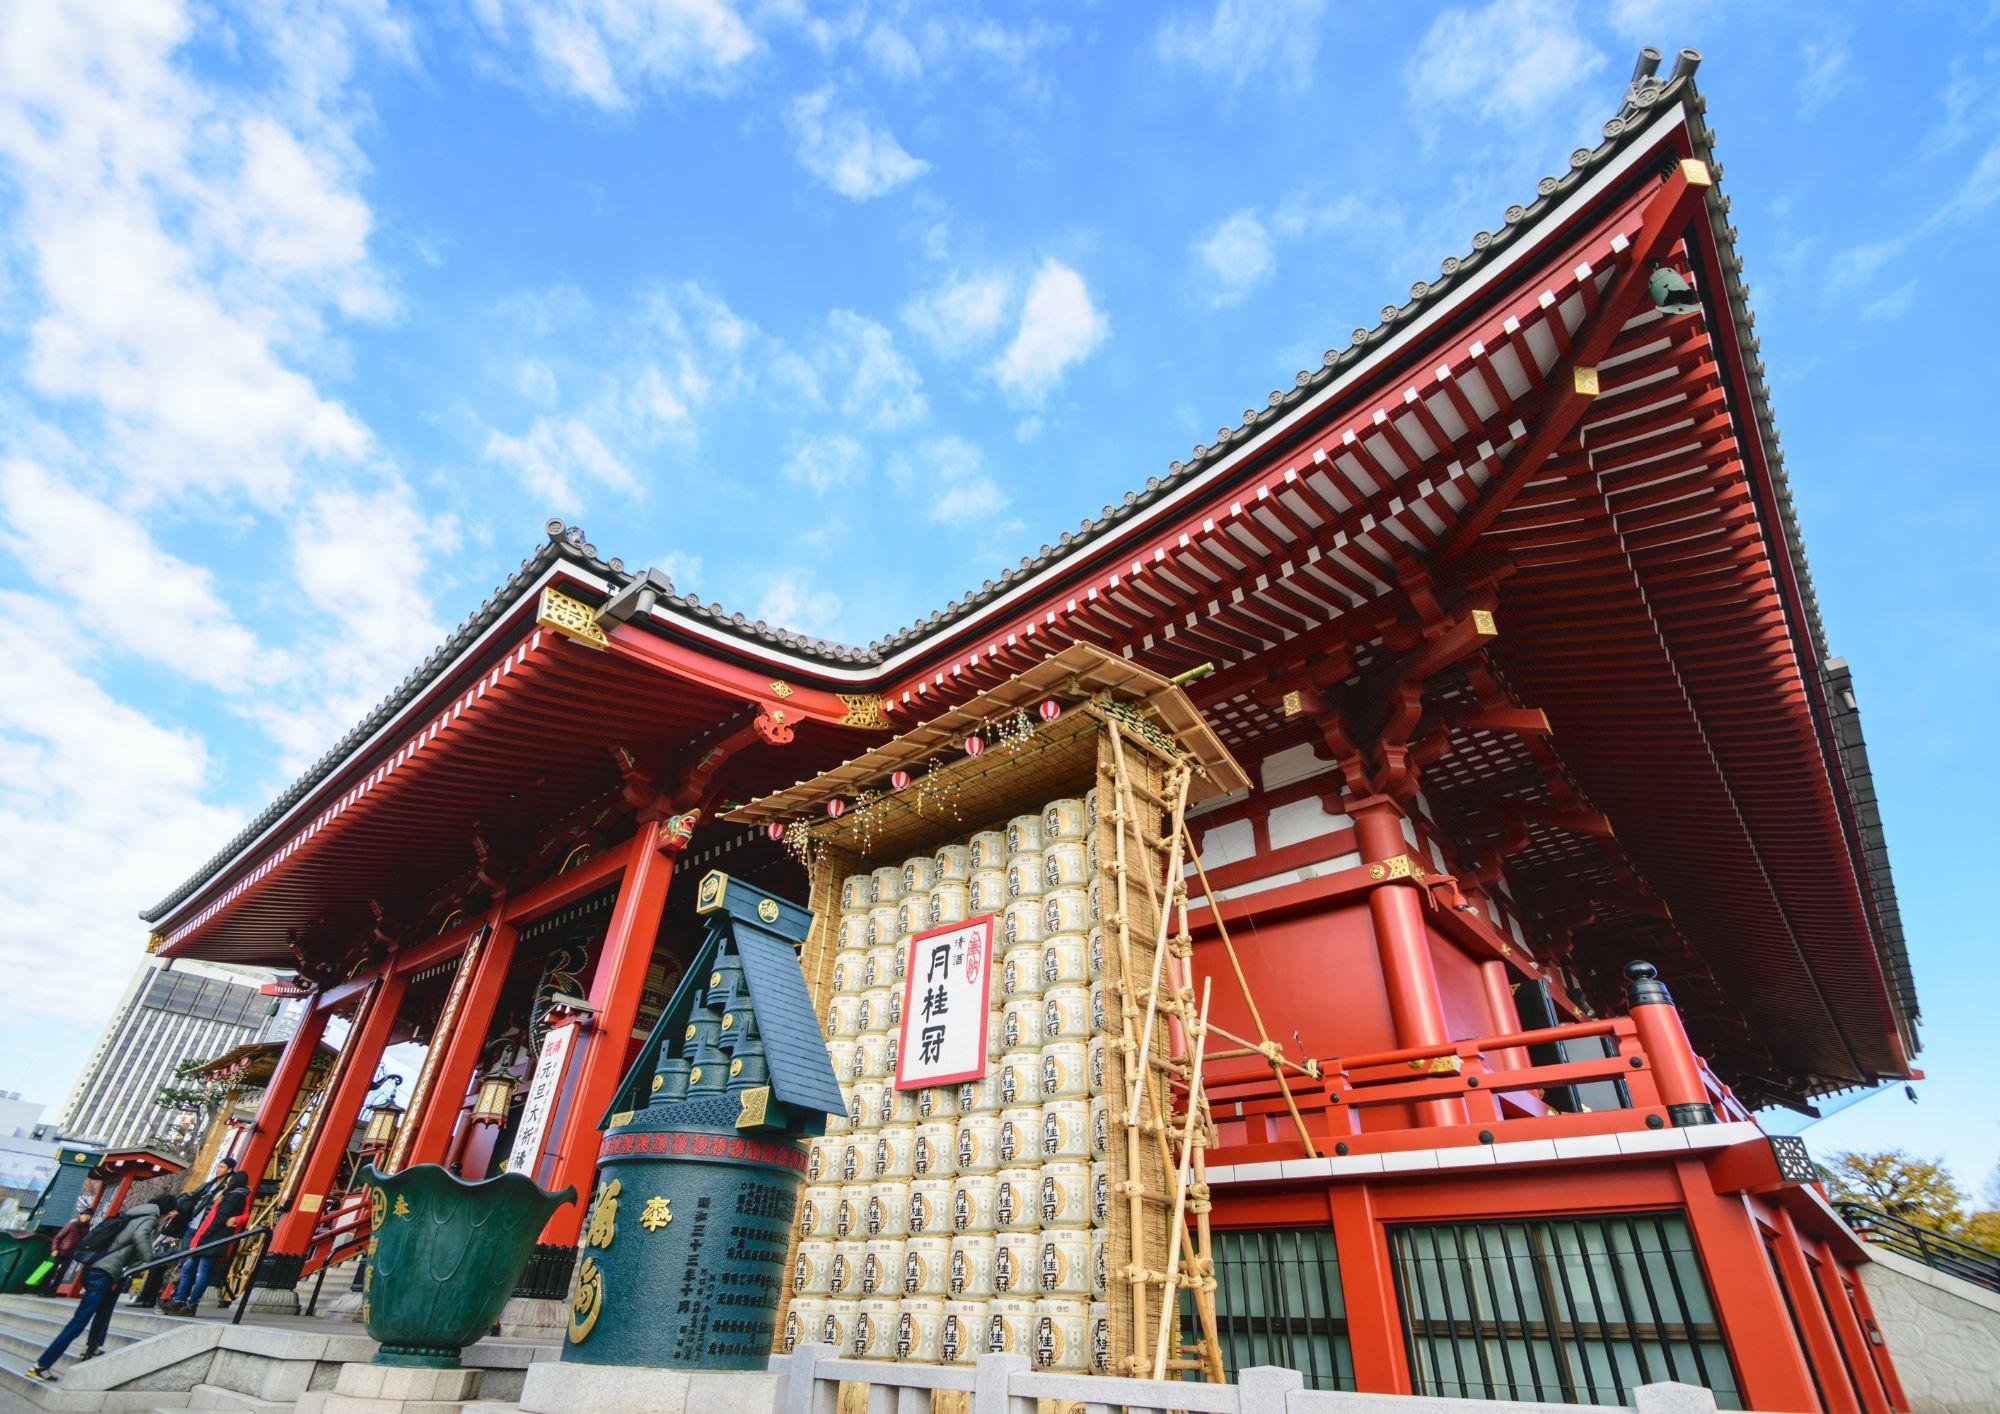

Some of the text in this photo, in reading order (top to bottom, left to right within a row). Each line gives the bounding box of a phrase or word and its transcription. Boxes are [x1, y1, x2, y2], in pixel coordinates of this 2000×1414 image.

[953, 936, 966, 966] 清酒
[919, 943, 951, 1066] 月桂冠
[851, 1094, 861, 1128] 月桂冠
[919, 1088, 931, 1117] 桂冠
[960, 1082, 971, 1111] 桂冠
[959, 1129, 971, 1167] 月桂冠
[1001, 1122, 1014, 1162] 月桂冠
[1044, 1112, 1058, 1154] 月桂冠
[809, 1146, 820, 1181] 月桂冠
[844, 1146, 856, 1181] 月桂冠
[875, 1139, 887, 1175] 月桂冠
[915, 1137, 927, 1174] 月桂冠
[639, 1196, 673, 1233] 奉
[801, 1200, 812, 1236] 月桂冠
[837, 1200, 848, 1236] 月桂冠
[868, 1196, 879, 1235] 月桂冠
[911, 1192, 923, 1233] 月桂冠
[955, 1189, 966, 1230] 月桂冠
[999, 1182, 1011, 1225] 月桂冠
[1043, 1177, 1056, 1221] 月桂冠
[794, 1253, 806, 1291] 月桂冠
[831, 1254, 844, 1293] 月桂冠
[863, 1253, 875, 1294] 月桂冠
[904, 1252, 918, 1293] 月桂冠
[951, 1250, 965, 1294] 月桂冠
[996, 1247, 1009, 1292] 月桂冠
[1043, 1243, 1057, 1290] 月桂冠
[823, 1315, 835, 1343] 月桂
[855, 1312, 868, 1356] 月桂冠
[896, 1313, 911, 1358] 月桂冠
[943, 1315, 957, 1361] 月桂冠
[1037, 1317, 1053, 1367] 月桂冠
